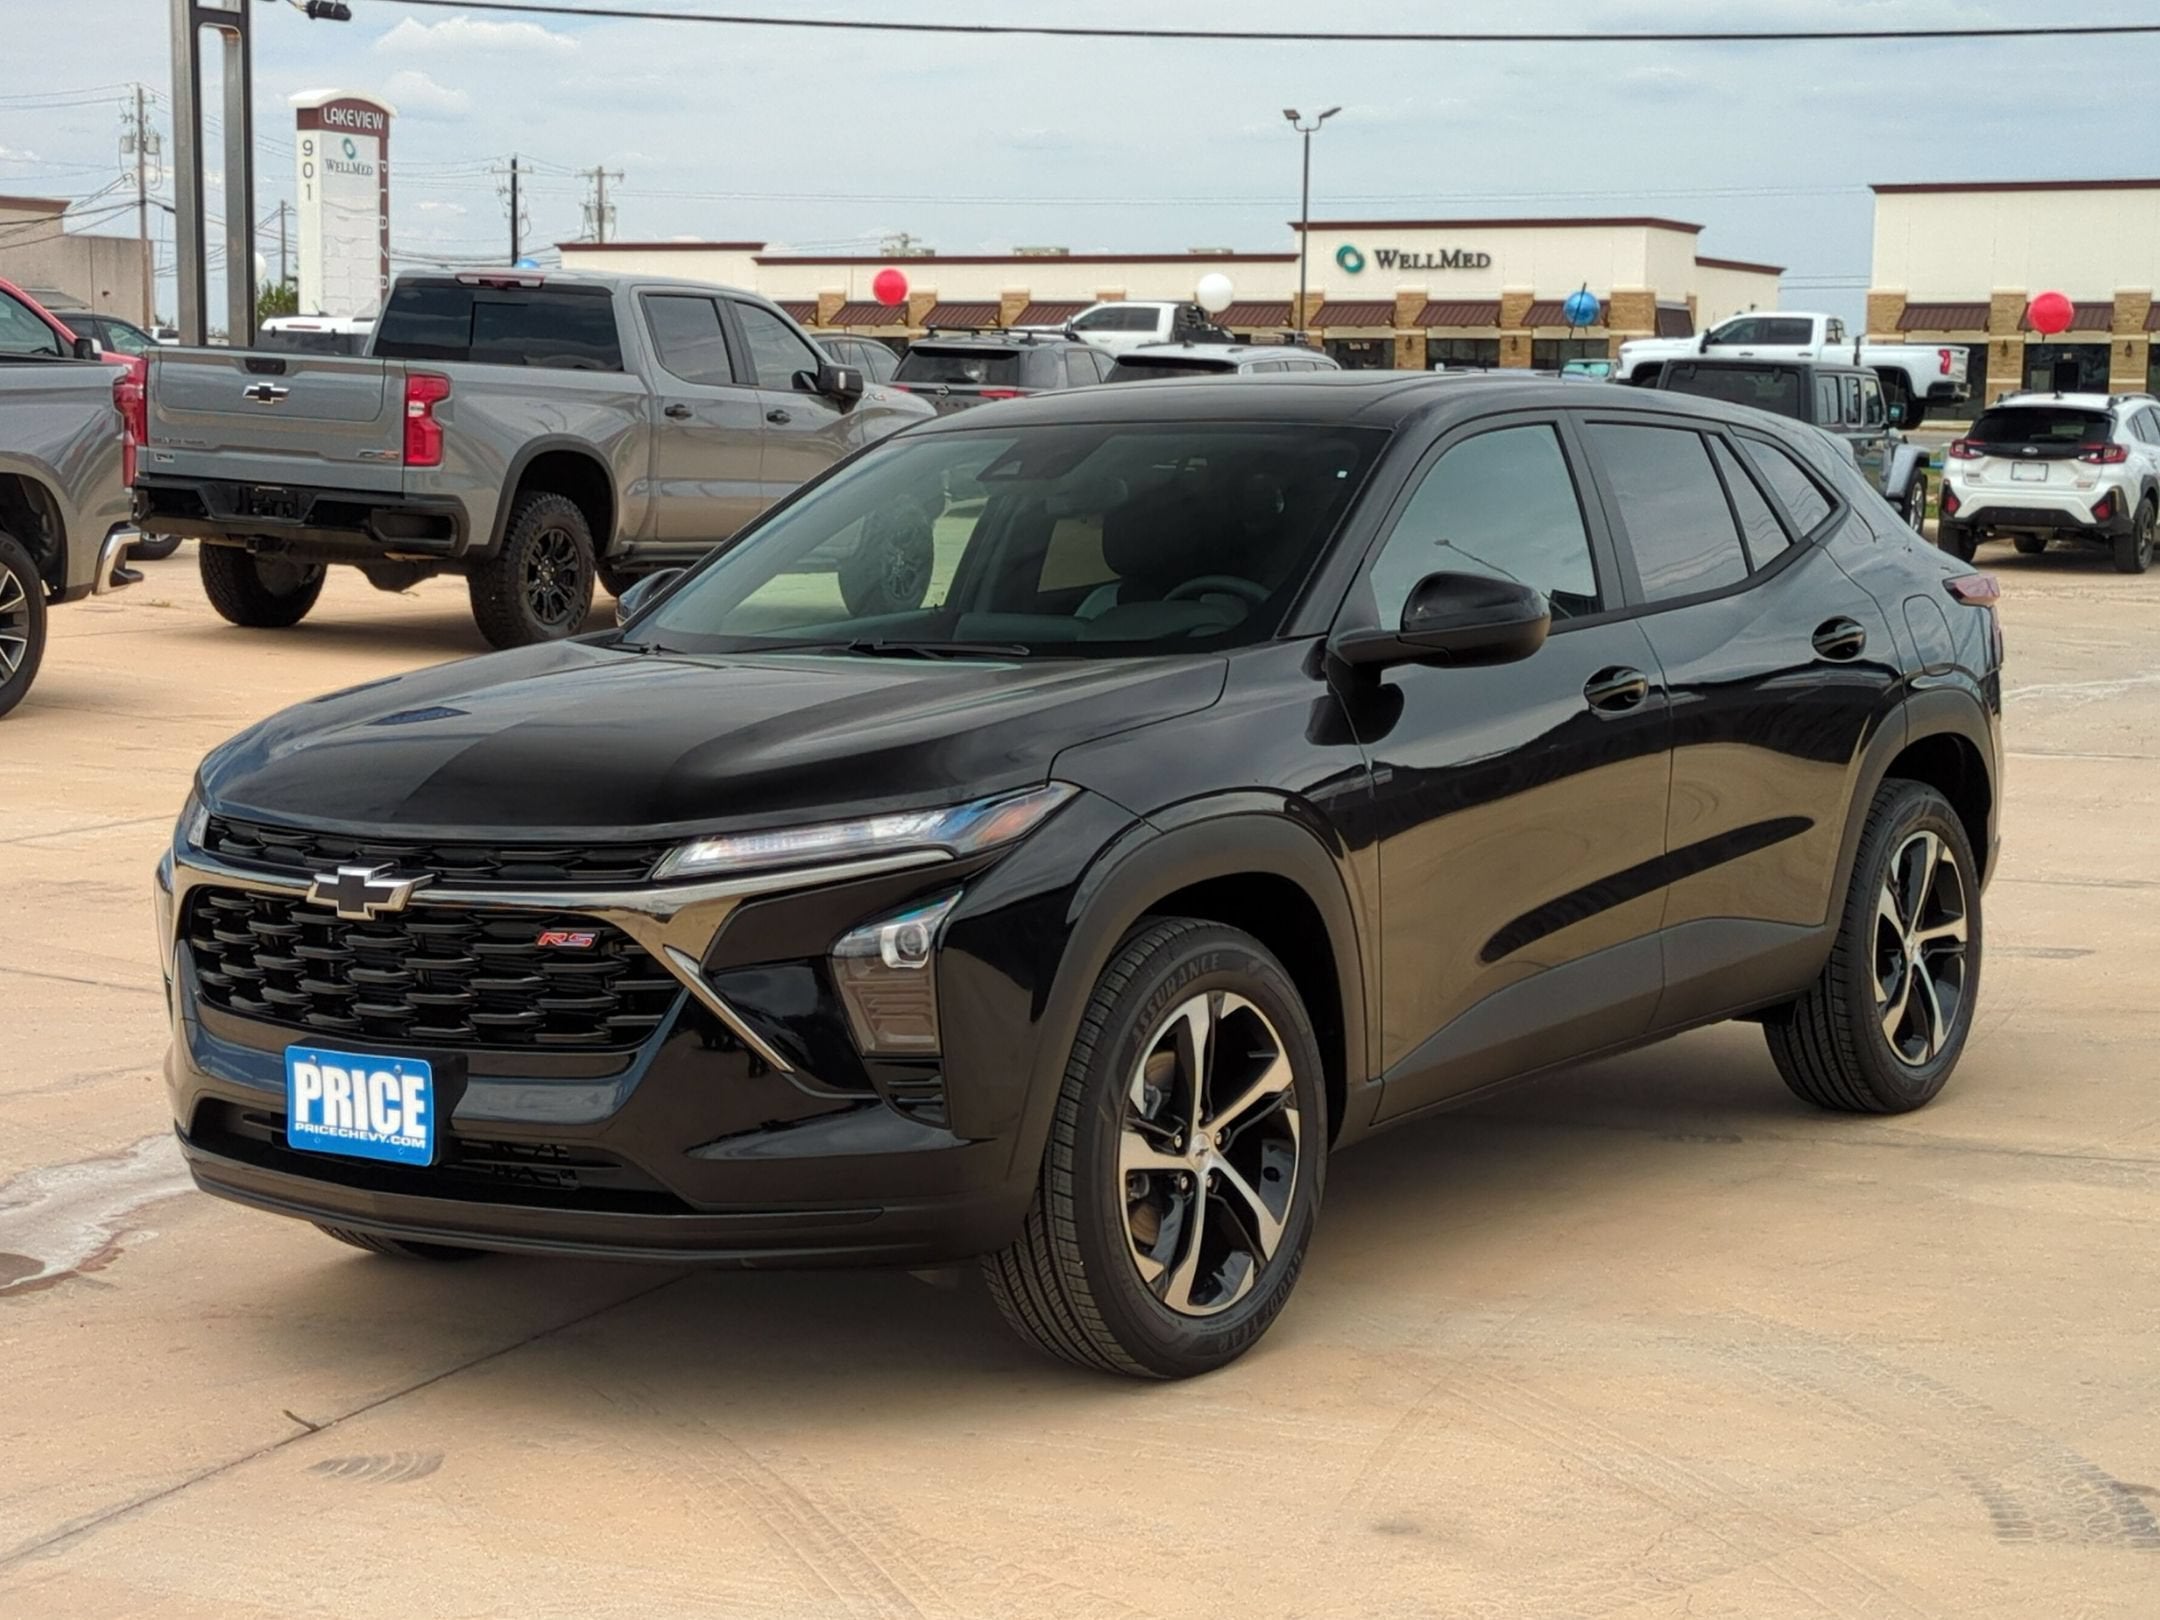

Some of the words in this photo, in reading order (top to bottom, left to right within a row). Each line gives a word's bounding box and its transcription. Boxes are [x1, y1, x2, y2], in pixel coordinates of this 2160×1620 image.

[323, 106, 384, 130] LAKEVIEW
[302, 139, 314, 201] 901
[538, 932, 596, 947] RS
[293, 1061, 427, 1138] PRICE
[294, 1122, 427, 1149] PRICECHEVY.COM
